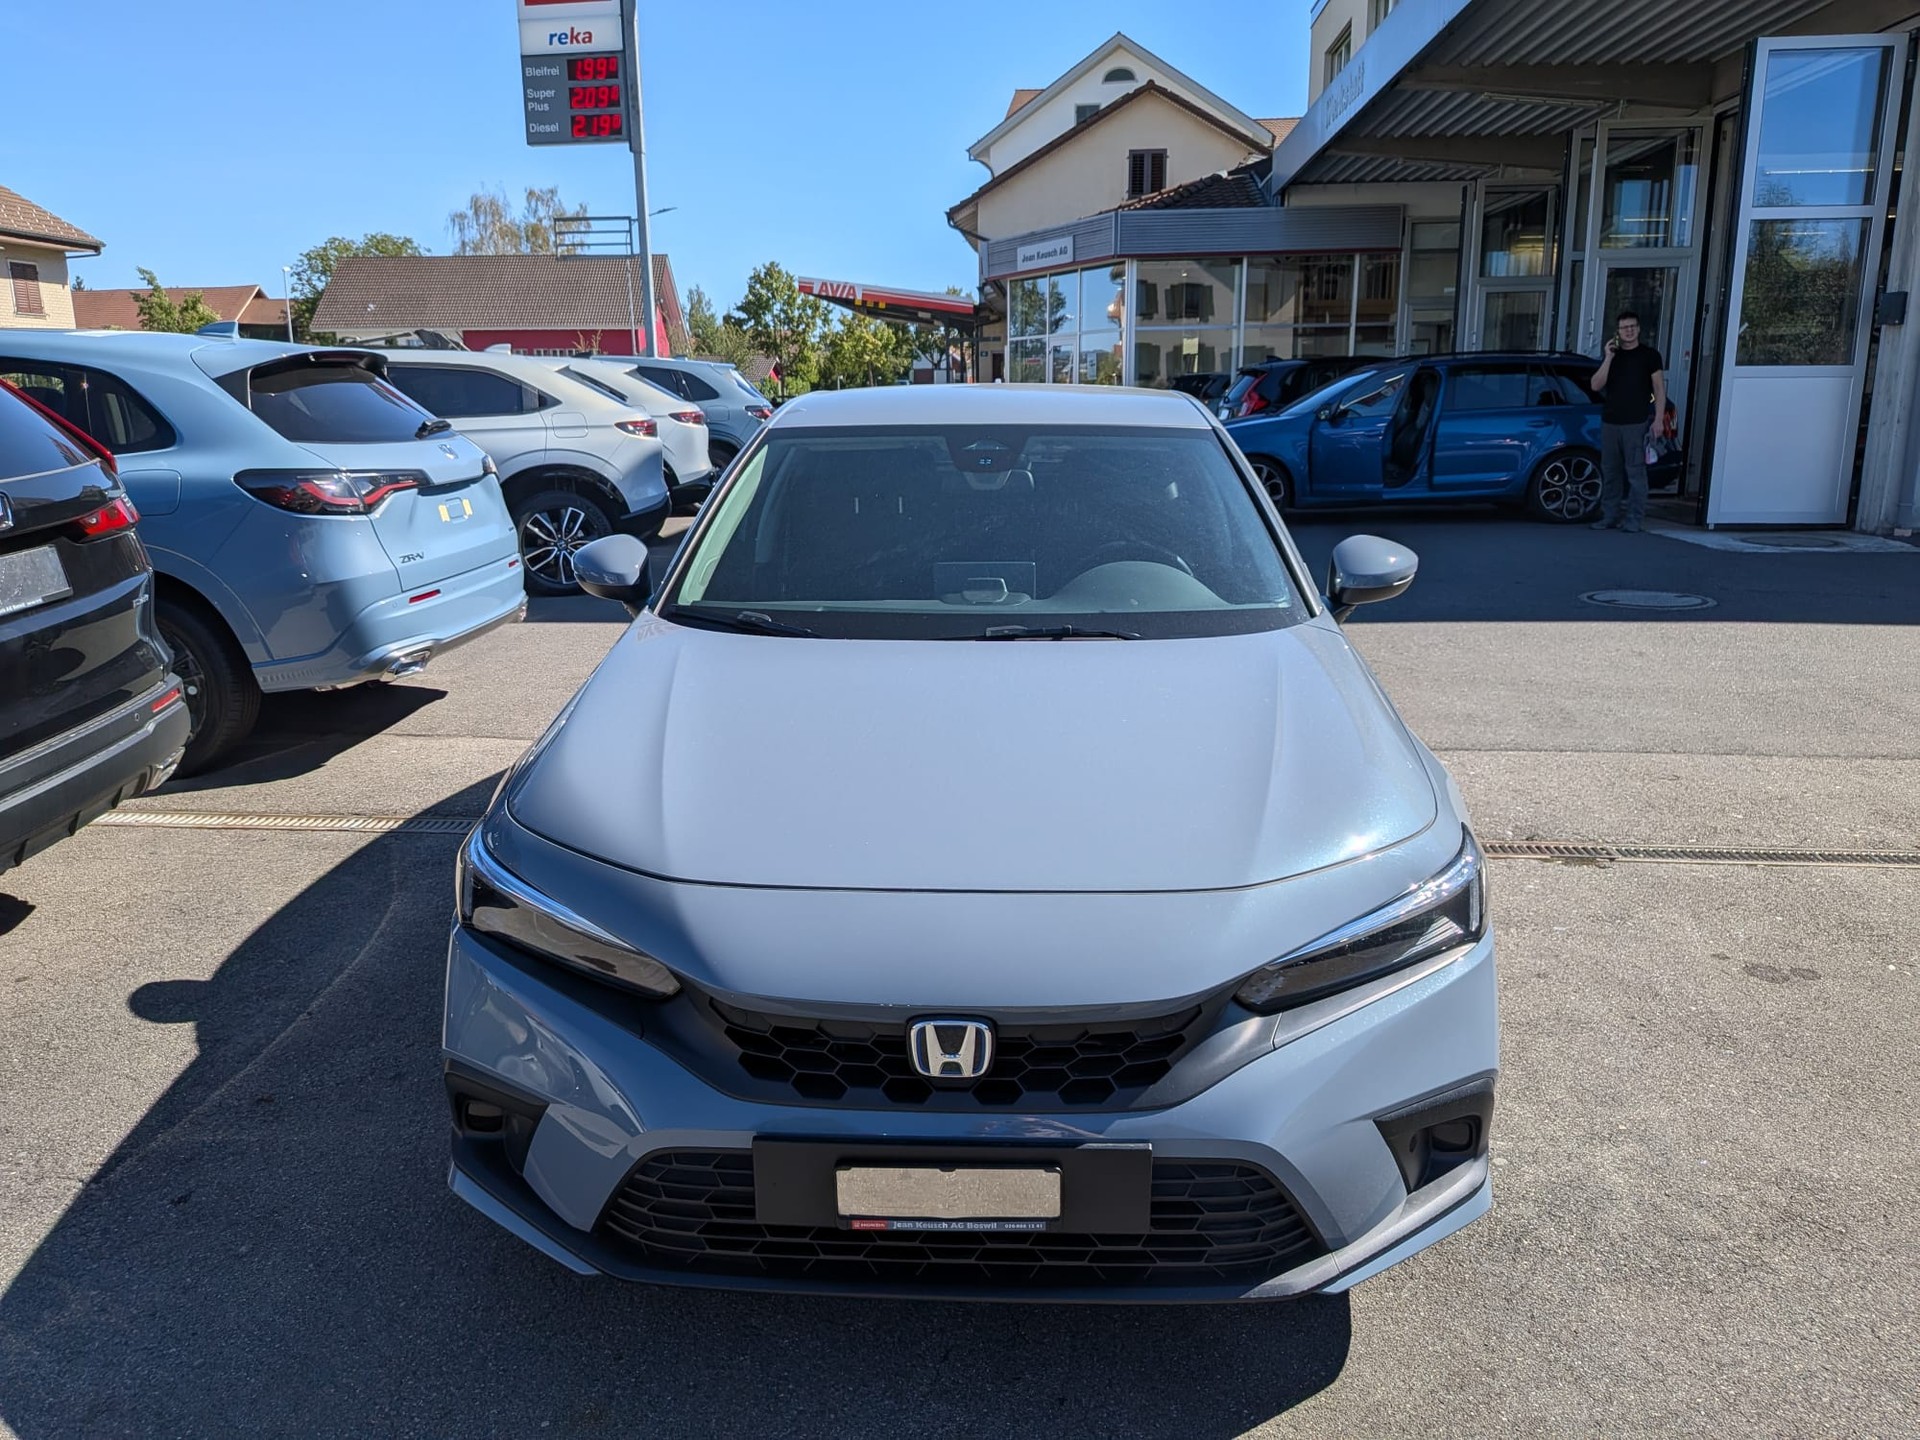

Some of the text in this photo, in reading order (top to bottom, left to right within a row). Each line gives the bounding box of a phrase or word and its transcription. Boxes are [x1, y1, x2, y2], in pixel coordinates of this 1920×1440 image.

[548, 27, 593, 45] reka
[525, 66, 559, 77] Bleifrei
[527, 88, 555, 100] Super
[528, 102, 550, 111] Plus
[530, 122, 559, 133] Diesel
[1022, 245, 1069, 263] Jean Keusch AG
[819, 281, 857, 299] AVIA
[399, 551, 425, 564] ZR-V
[893, 1221, 914, 1229] Jean
[916, 1221, 948, 1229] Keusch
